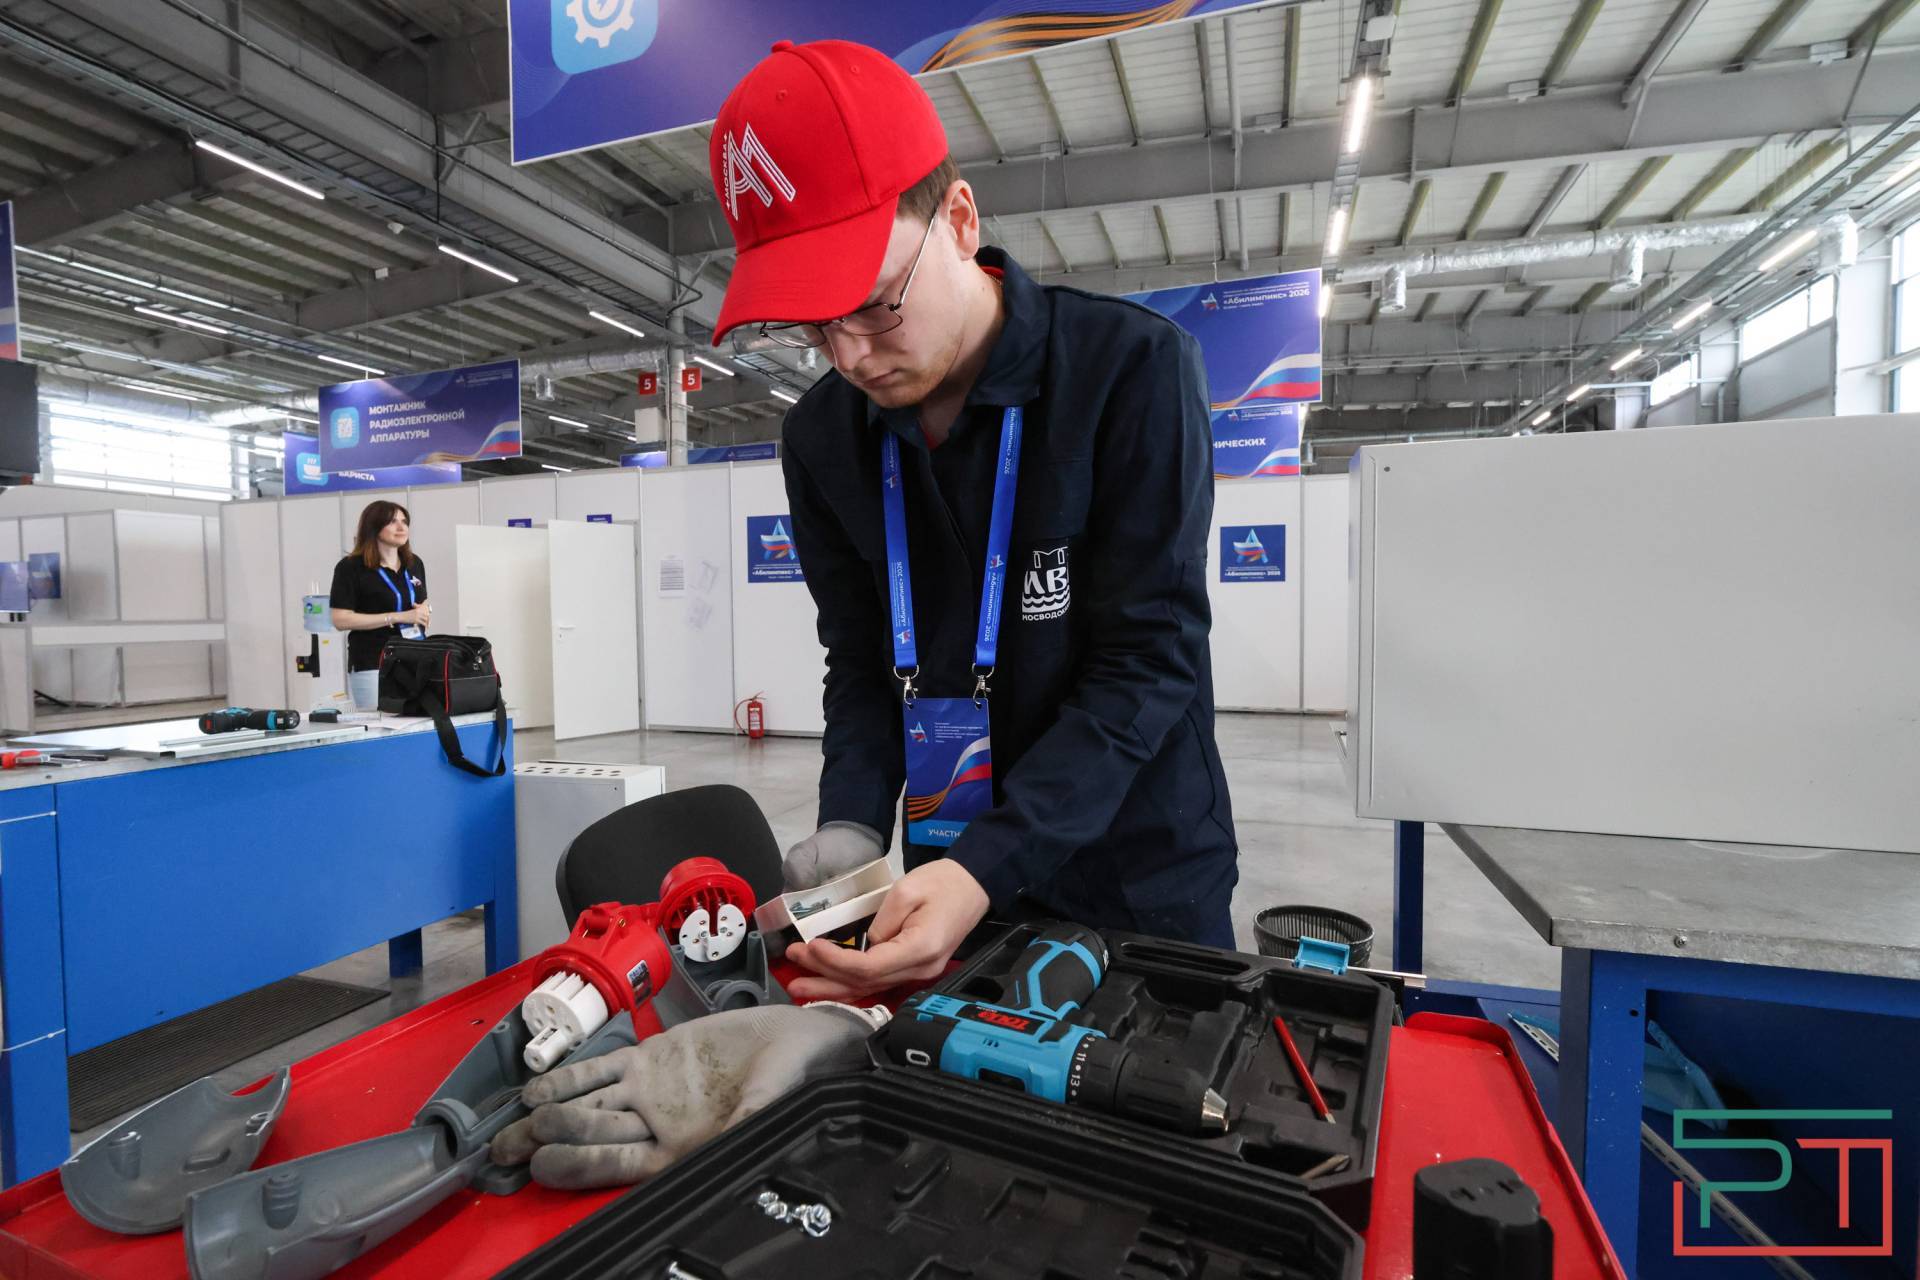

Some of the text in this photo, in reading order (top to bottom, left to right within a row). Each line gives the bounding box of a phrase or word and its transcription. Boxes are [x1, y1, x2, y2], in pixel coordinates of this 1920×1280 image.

[722, 143, 731, 200] МОСКВА
[1288, 288, 1310, 298] 2026
[643, 378, 652, 390] 5
[686, 373, 696, 386] 5
[368, 401, 426, 415] МОНТАЖНИК
[369, 408, 465, 430] РАДИОЭЛЕКТРОННОЙ
[369, 429, 430, 443] АППАРАТУРЫ
[984, 624, 992, 642] 2026
[928, 828, 962, 838] УЧАСТН
[1075, 1051, 1087, 1062] 11
[1070, 1074, 1081, 1087] 13
